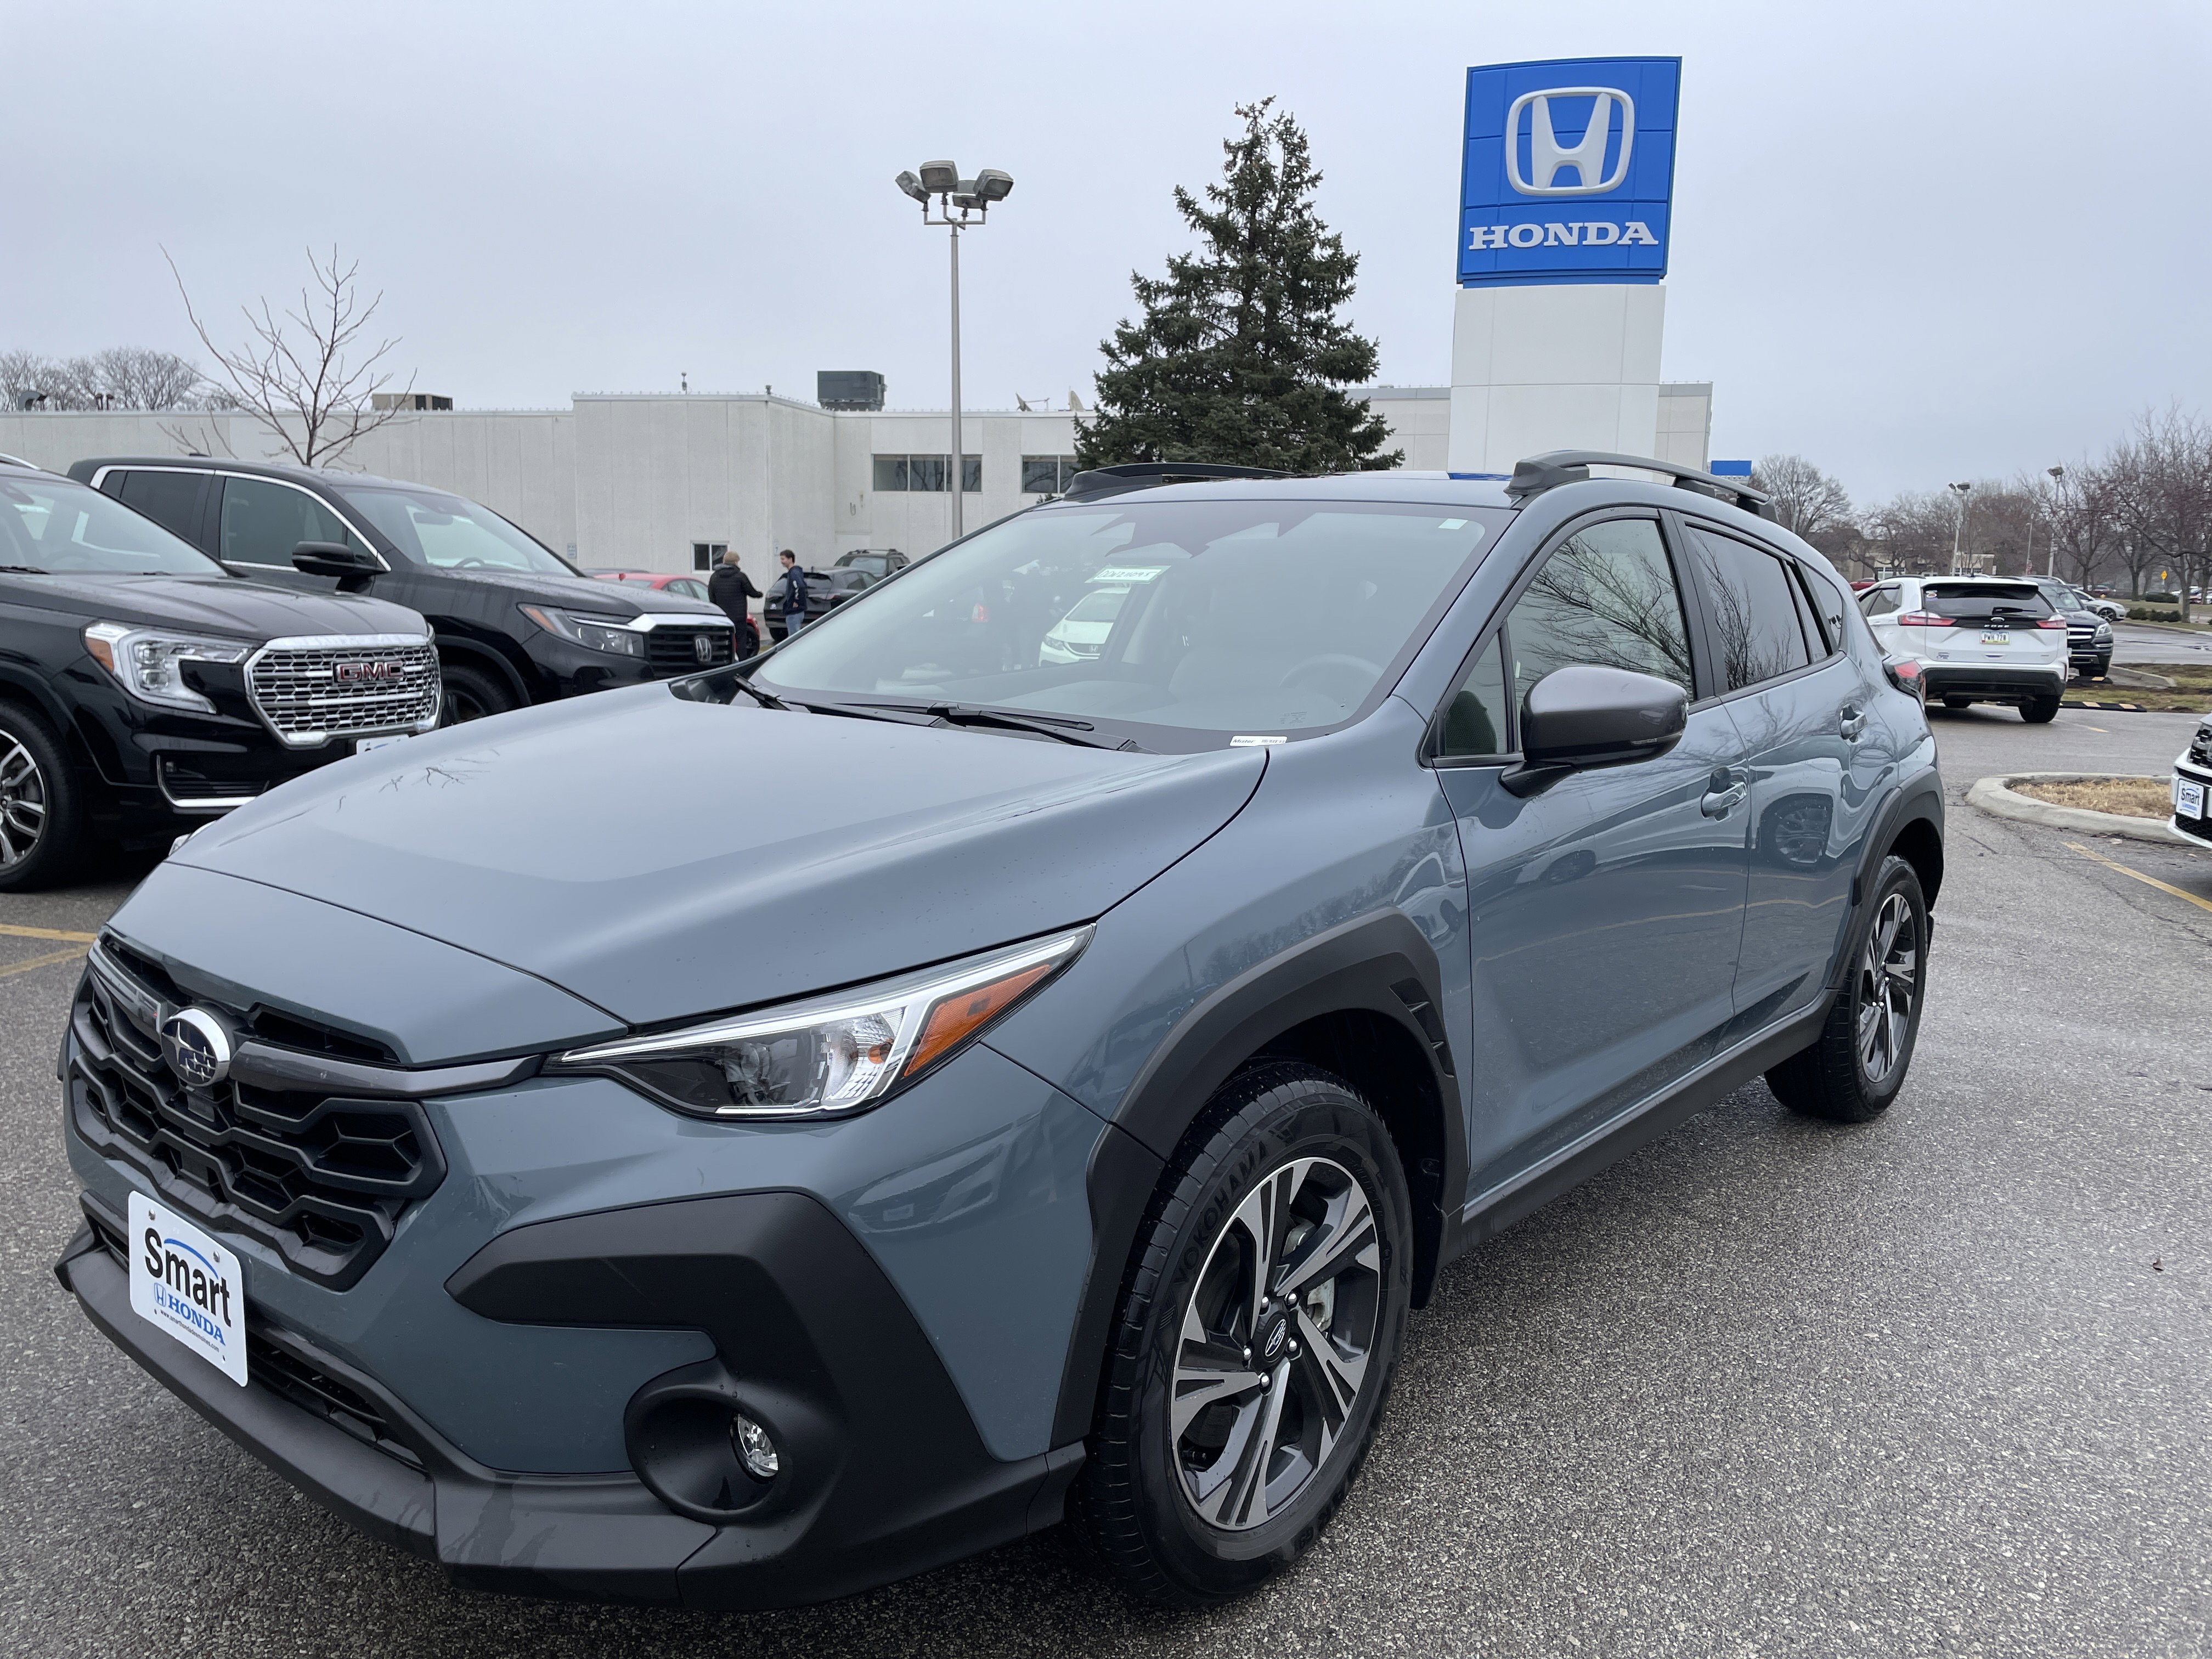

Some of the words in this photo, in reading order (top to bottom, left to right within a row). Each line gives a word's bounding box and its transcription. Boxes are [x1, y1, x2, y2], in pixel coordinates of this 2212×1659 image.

[1468, 222, 1659, 250] HONDA
[336, 661, 404, 682] GMC
[2181, 787, 2200, 806] Smart
[1173, 1141, 1269, 1284] YOKOHAMA
[144, 1227, 232, 1328] Smart
[168, 1294, 225, 1346] HONDA
